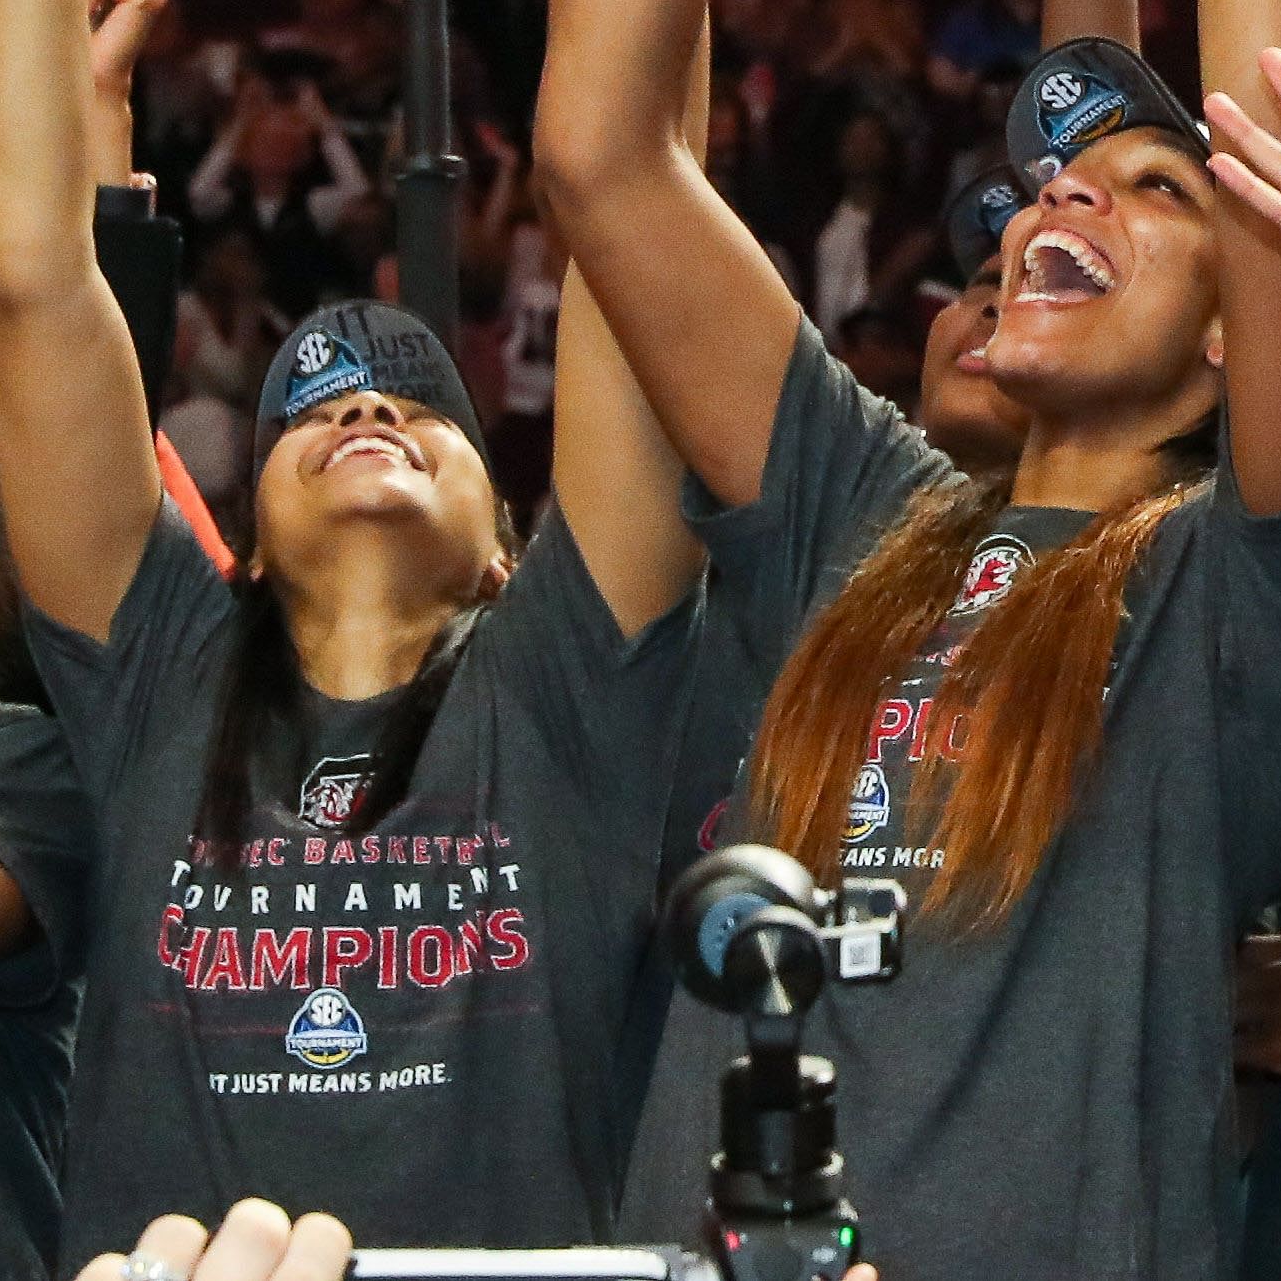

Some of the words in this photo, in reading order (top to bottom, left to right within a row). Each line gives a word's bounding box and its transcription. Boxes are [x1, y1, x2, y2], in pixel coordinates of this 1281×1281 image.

[1039, 72, 1083, 109] SEC
[1052, 94, 1130, 151] TOURNAMENT
[295, 331, 331, 374] SEC
[284, 369, 368, 418] TOURNAMENT
[170, 860, 520, 915] TOURNAMENT
[157, 902, 531, 991] CHAMPIONS
[230, 1072, 283, 1094] JUST
[288, 1072, 372, 1093] MEANS
[377, 1063, 453, 1092] MORE.
